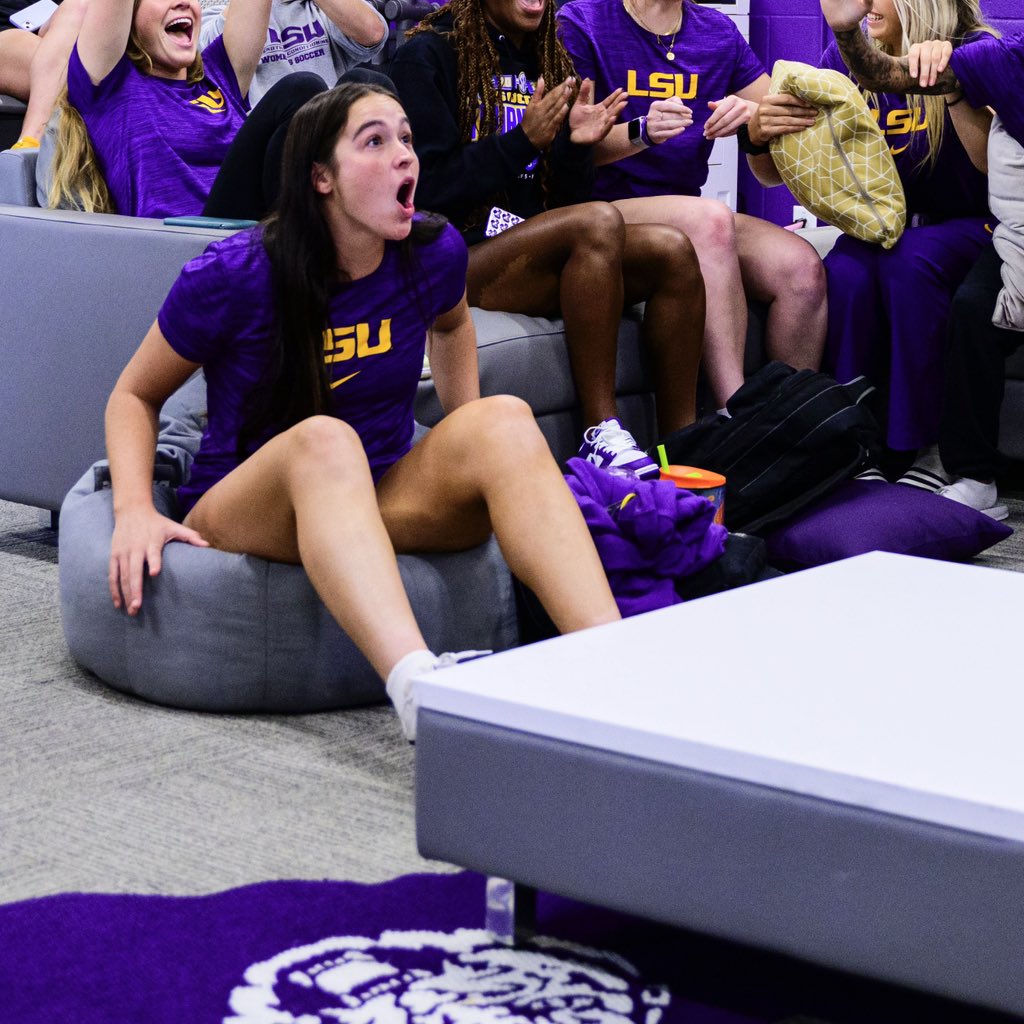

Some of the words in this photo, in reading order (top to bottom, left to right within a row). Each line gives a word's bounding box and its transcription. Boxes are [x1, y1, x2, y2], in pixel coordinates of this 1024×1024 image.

[294, 48, 325, 64] SOCCER
[627, 69, 698, 100] LSU
[322, 318, 392, 364] SU
